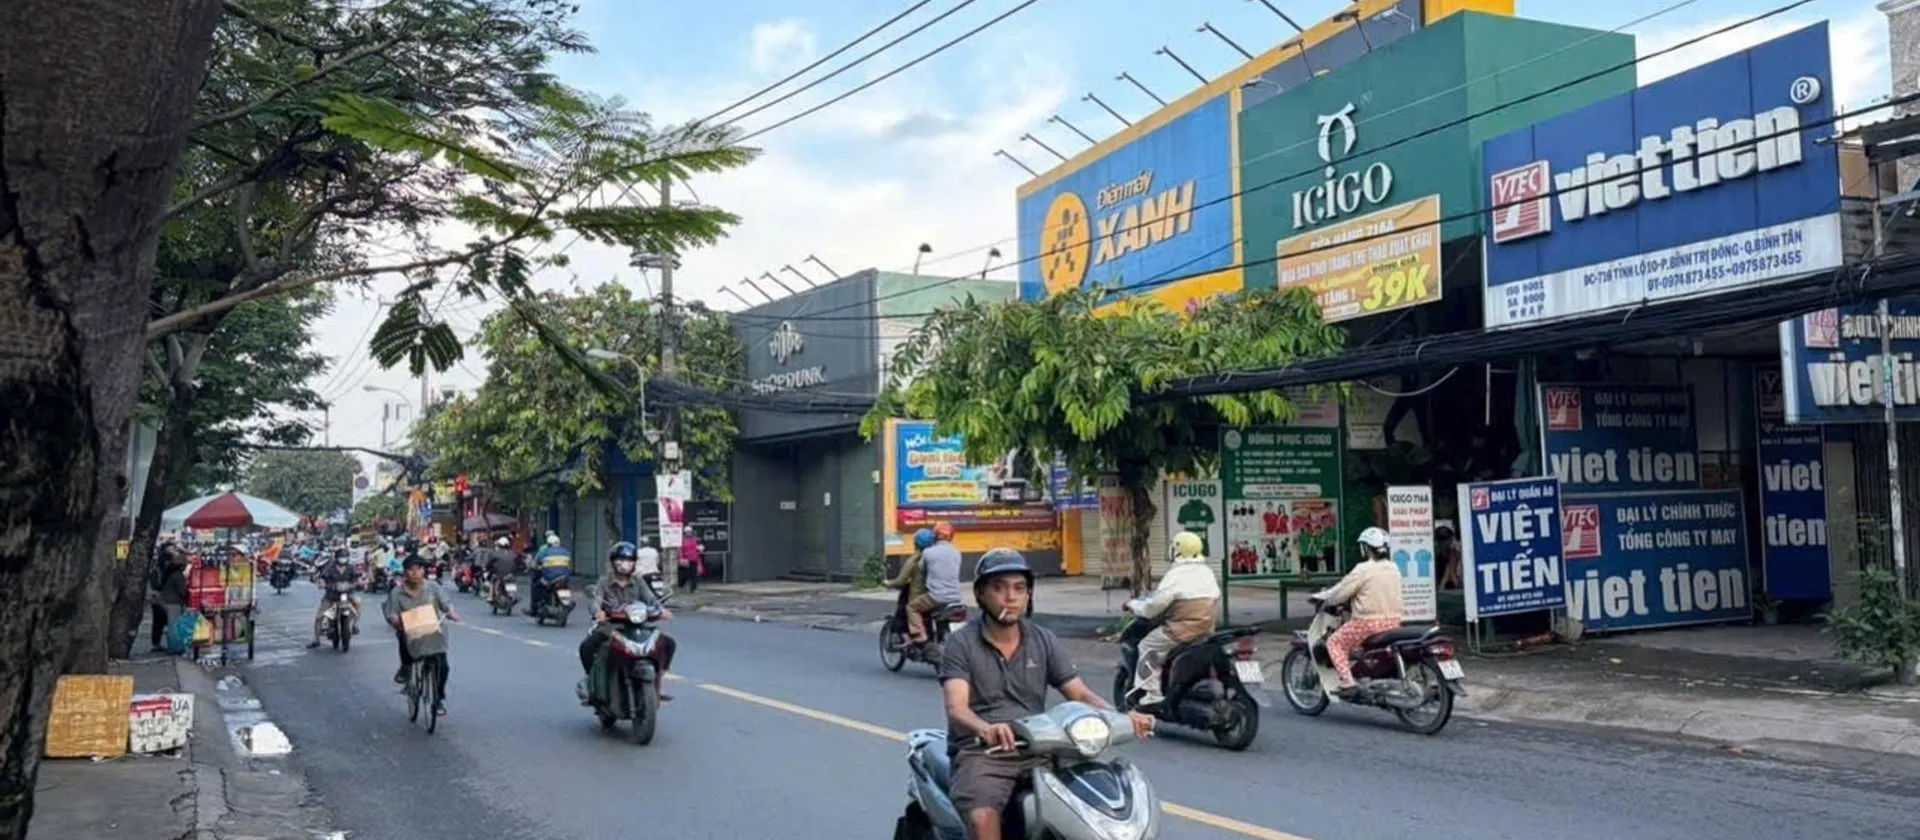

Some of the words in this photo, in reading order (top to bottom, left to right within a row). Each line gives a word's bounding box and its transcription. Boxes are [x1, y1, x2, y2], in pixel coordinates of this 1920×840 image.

[1495, 168, 1540, 202] VTEC
[1094, 180, 1196, 266] XANH
[1363, 263, 1431, 311] 39K
[1550, 446, 1620, 484] viet
[1628, 446, 1696, 483] tien
[1764, 459, 1824, 491] viet
[1173, 483, 1217, 498] ICUGO
[1477, 503, 1554, 546] VIỆT
[1617, 506, 1640, 526] ĐẠI
[1642, 501, 1658, 522] LÝ
[1662, 502, 1701, 520] CHÍNH
[1766, 513, 1827, 546] tien
[1618, 527, 1653, 551] TỔNG
[1656, 528, 1690, 548] CÔNG
[1693, 530, 1708, 546] TY
[1711, 528, 1737, 545] MAY
[1478, 548, 1560, 594] TIẾN
[1564, 569, 1649, 621] viet
[1660, 563, 1745, 613] tien
